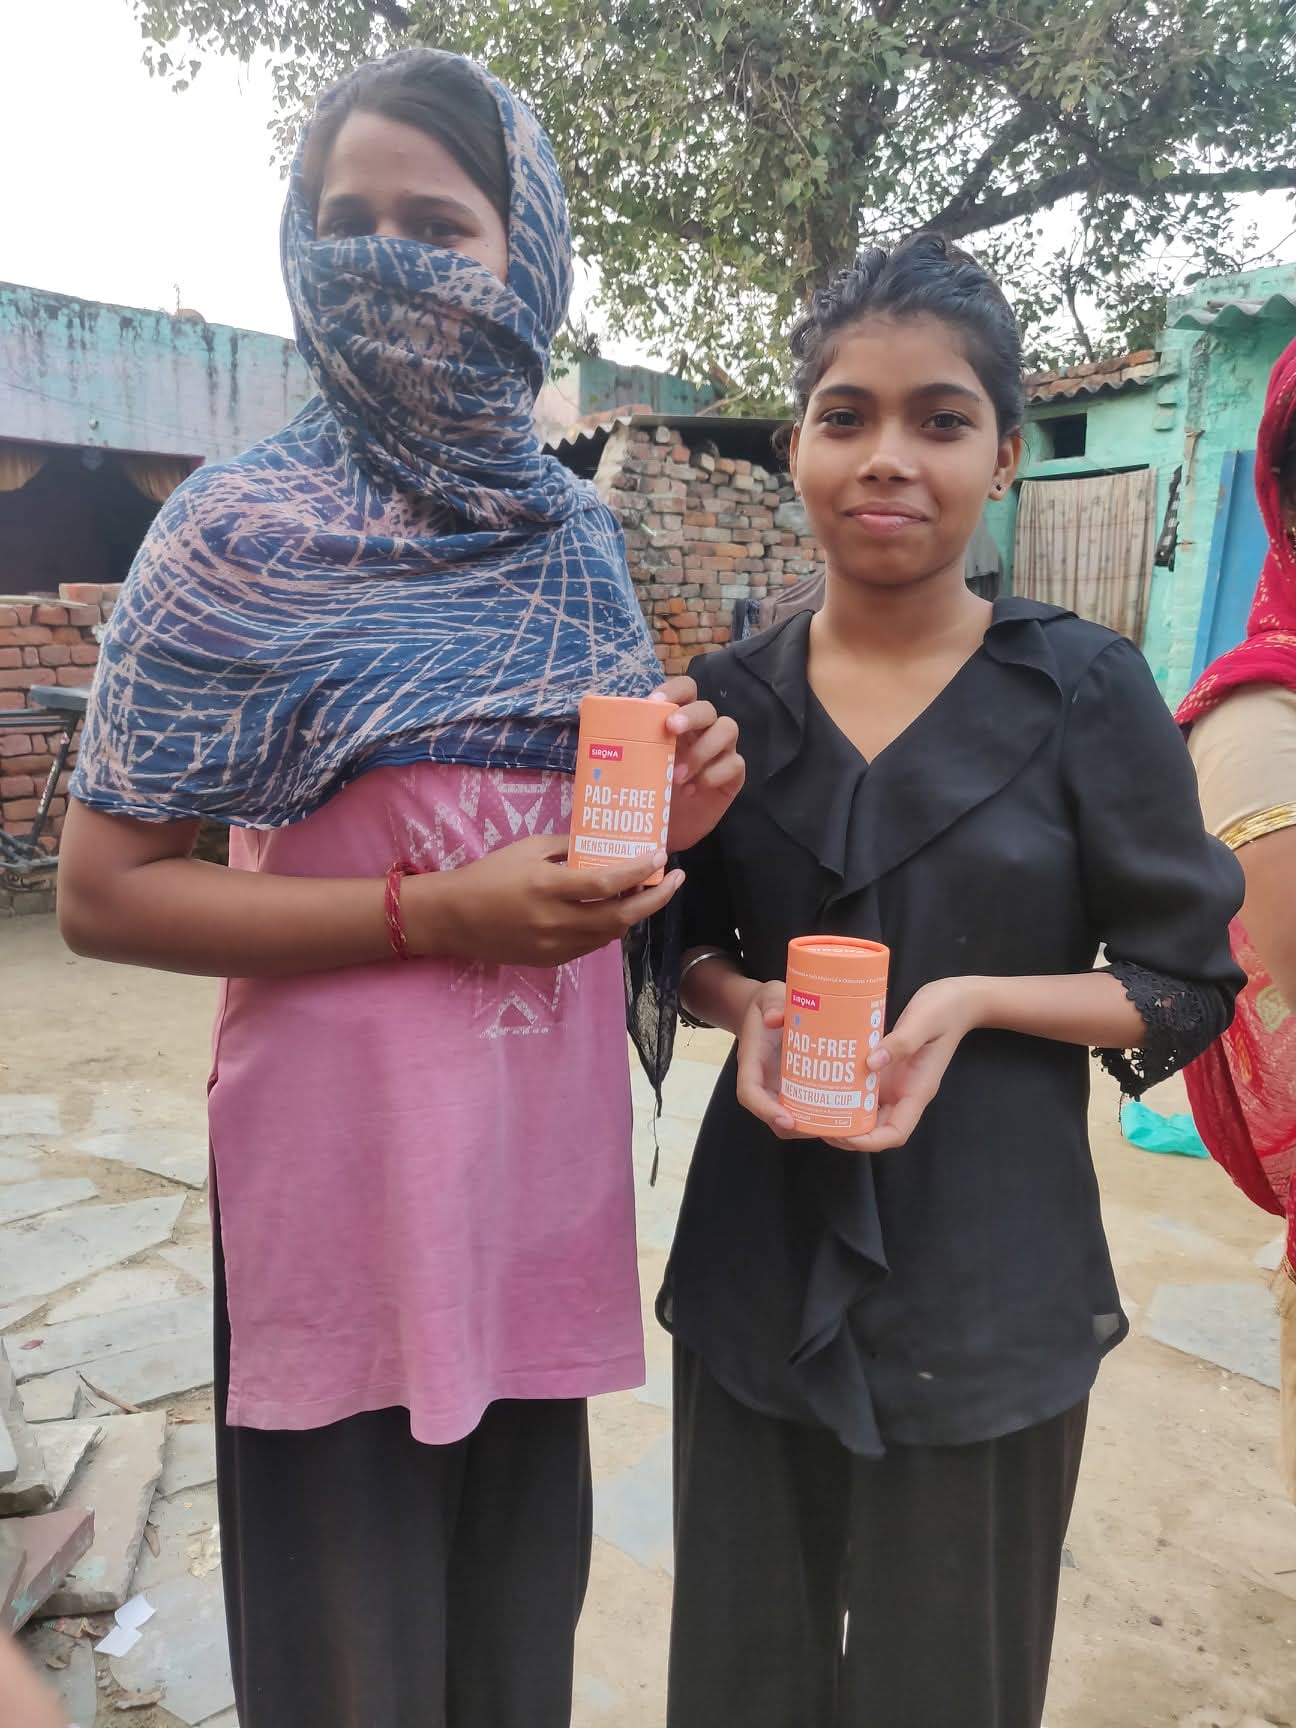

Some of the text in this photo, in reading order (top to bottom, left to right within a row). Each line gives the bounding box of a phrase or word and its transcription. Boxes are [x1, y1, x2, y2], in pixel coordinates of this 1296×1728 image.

[591, 748, 618, 759] SIRONA
[584, 784, 656, 809] PAD-FREE
[582, 806, 654, 833] PERIODS
[580, 839, 632, 856] MENSTRUAL
[787, 1028, 857, 1058] PAD-FREE
[786, 1052, 855, 1083] PERIODS
[784, 1081, 830, 1105] MENSTRUAL
[834, 1094, 853, 1106] CUP
